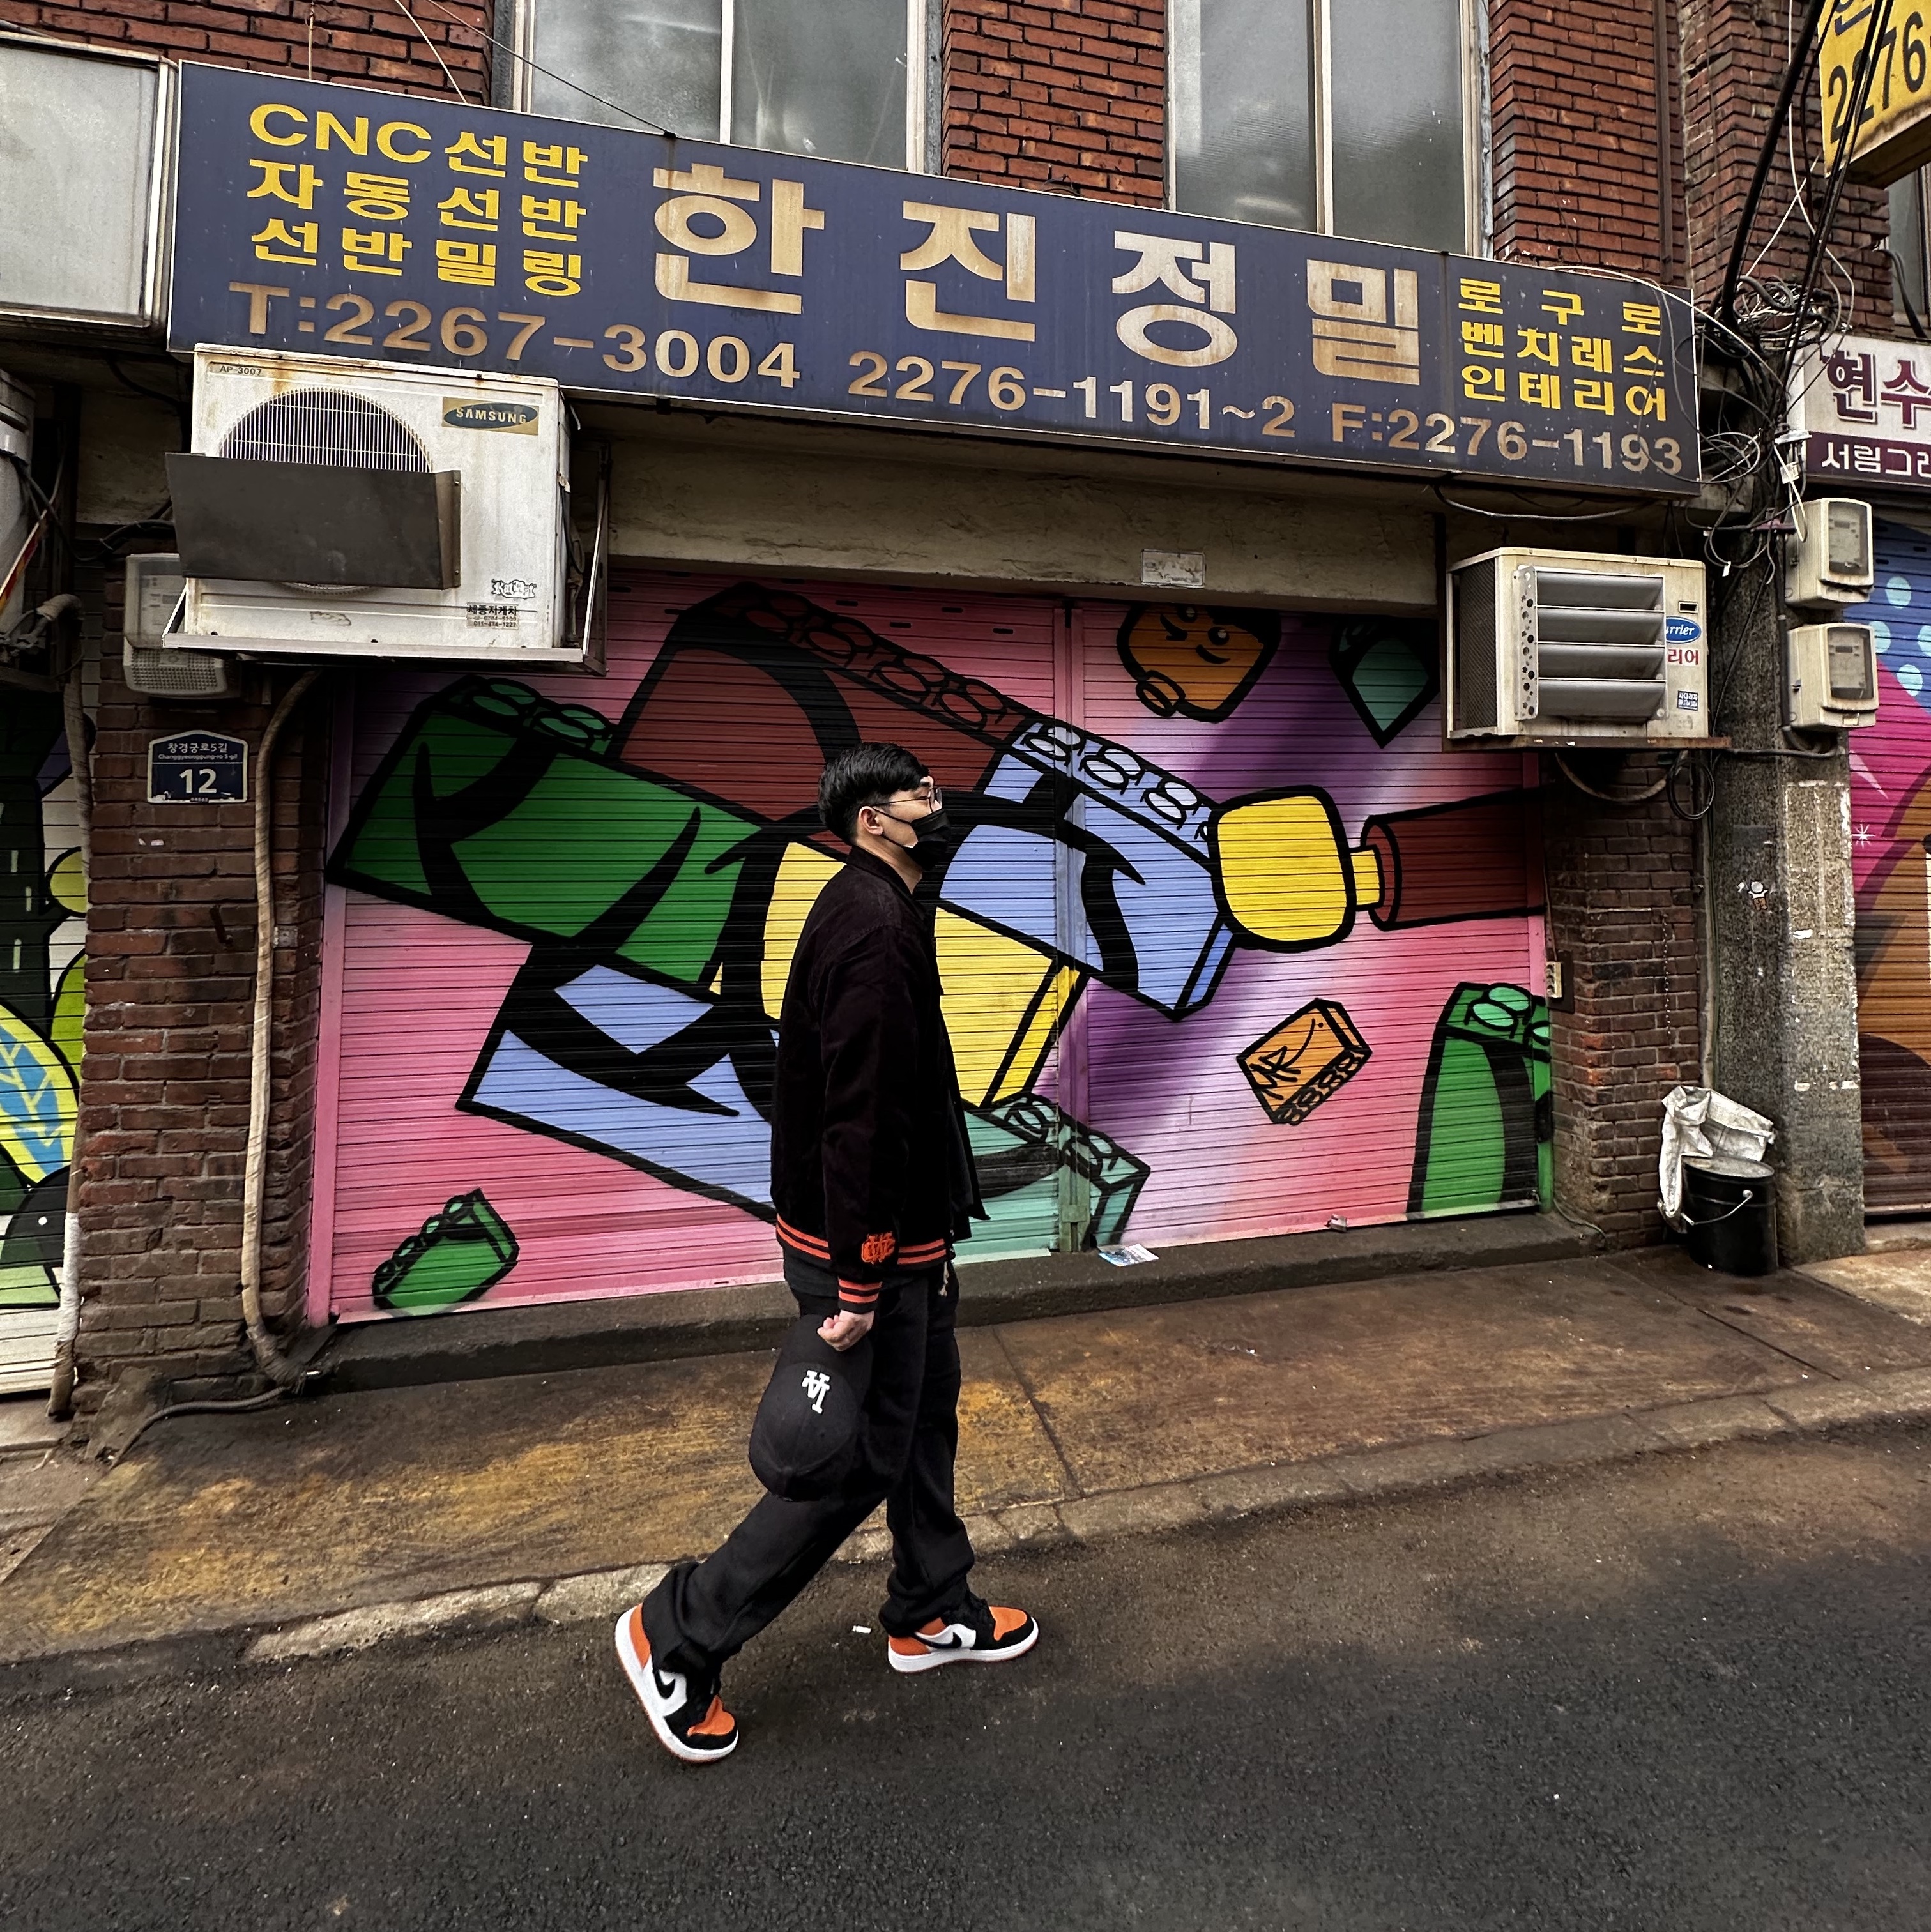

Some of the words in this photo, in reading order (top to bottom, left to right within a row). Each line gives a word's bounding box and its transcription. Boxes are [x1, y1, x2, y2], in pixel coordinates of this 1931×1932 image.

[220, 365, 262, 376] AP-3007
[1462, 365, 1667, 422] 인테리어
[455, 407, 527, 424] SAMSUNG
[167, 743, 228, 754] 창경궁로5길
[179, 768, 217, 793] 12
